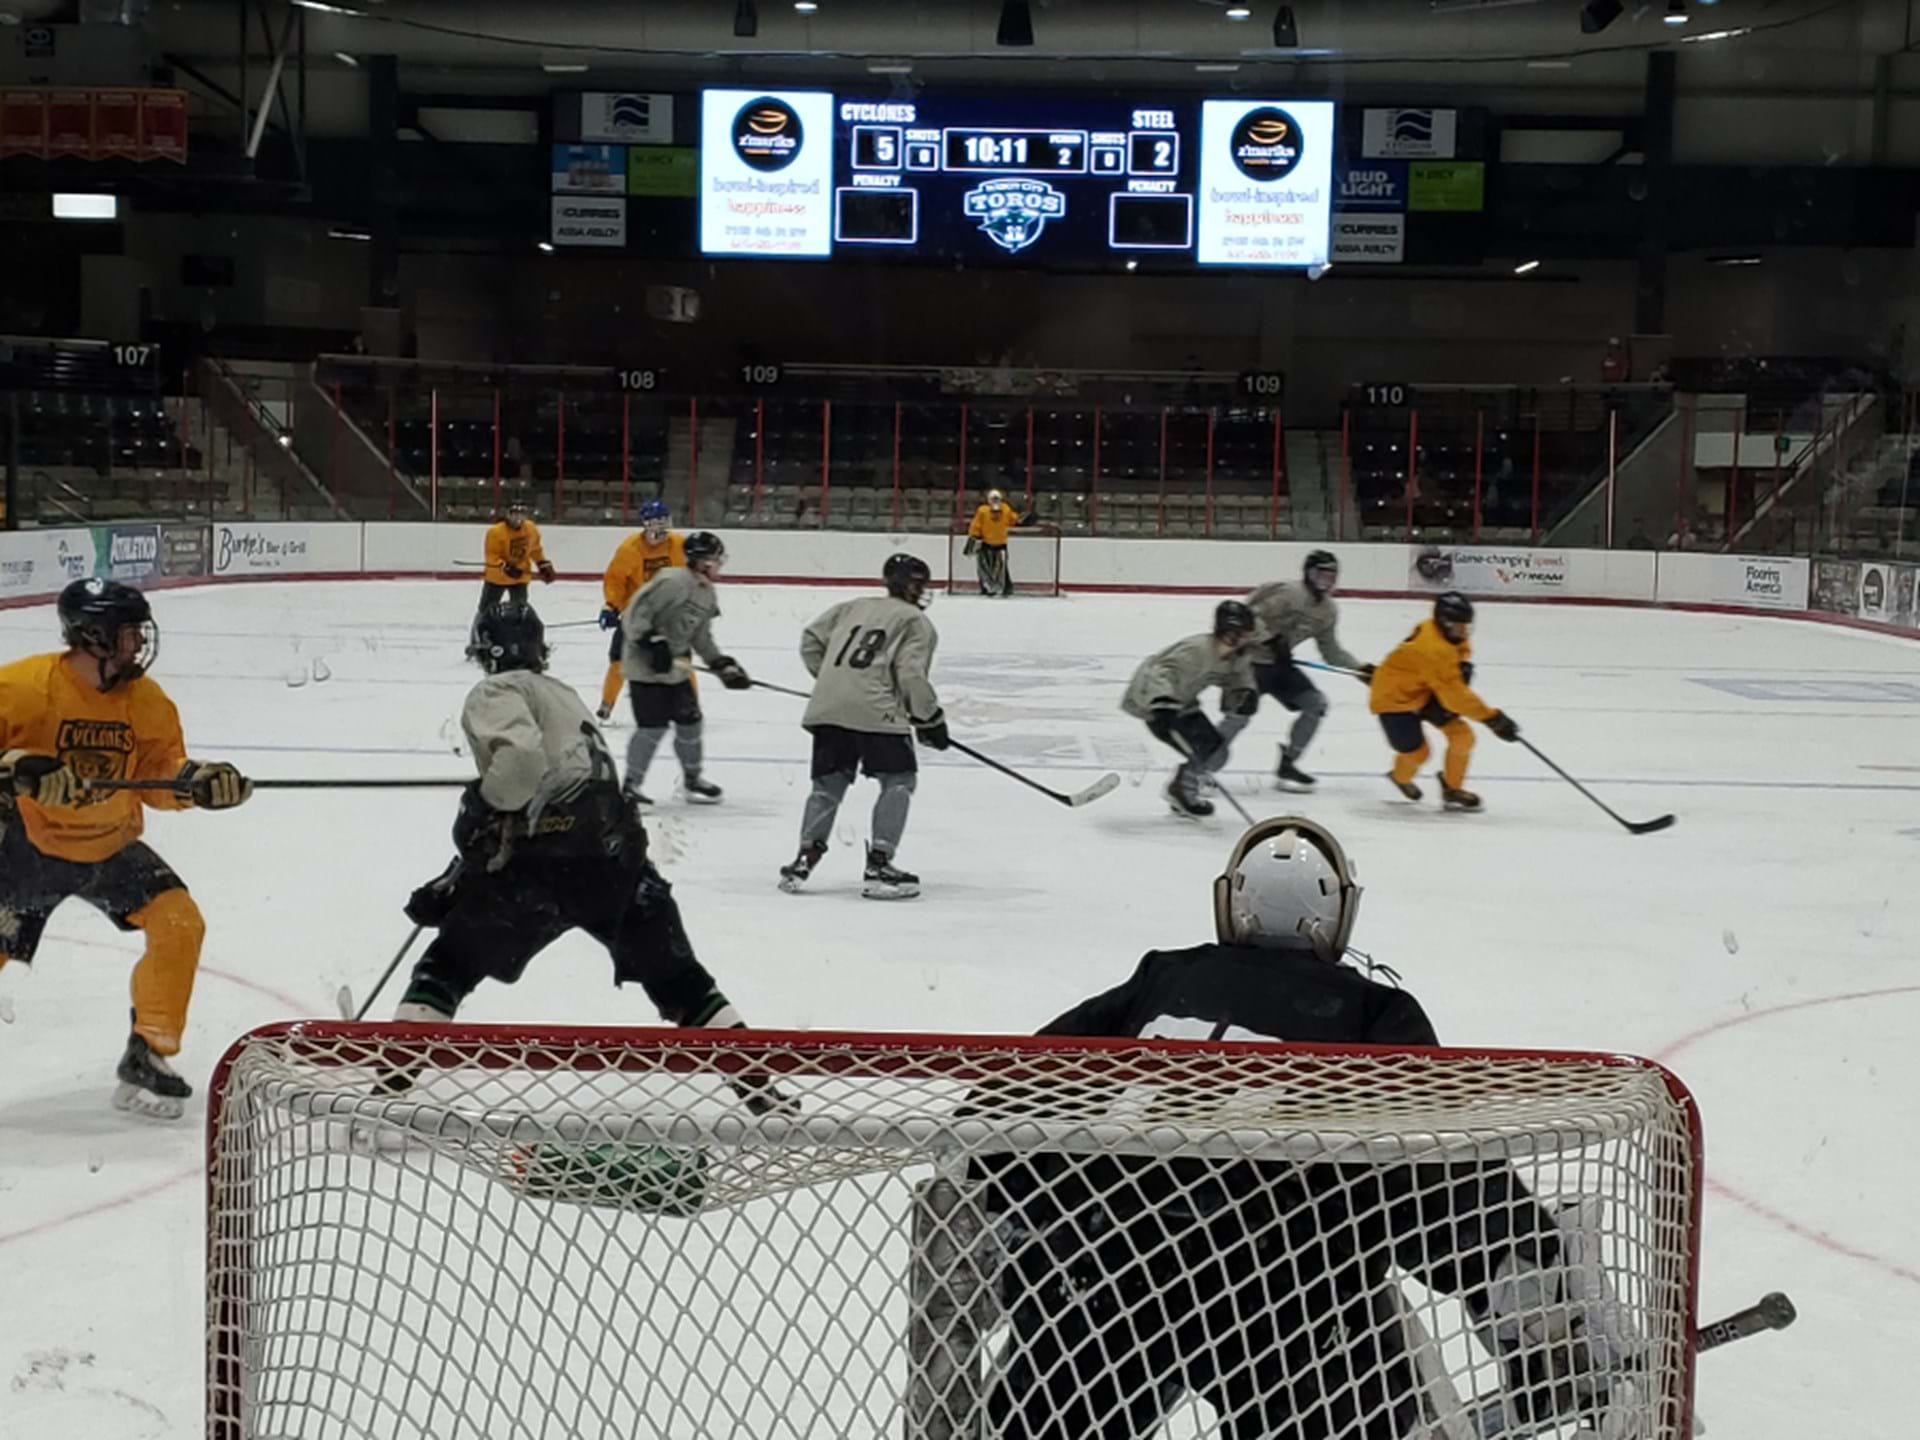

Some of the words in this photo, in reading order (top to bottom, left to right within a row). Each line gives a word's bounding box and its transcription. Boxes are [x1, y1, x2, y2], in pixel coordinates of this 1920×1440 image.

[841, 103, 916, 122] CYCLONES
[1132, 110, 1175, 128] STEEL
[877, 136, 894, 161] 5
[919, 149, 930, 163] 0
[964, 137, 1028, 163] 10:11
[1058, 148, 1071, 165] 2
[1154, 141, 1171, 167] 2
[1104, 153, 1115, 167] 0
[853, 174, 901, 186] PENALTY
[1348, 171, 1388, 183] BUD
[1128, 180, 1177, 193] PENALTY
[1341, 183, 1396, 196] LIGHT
[971, 193, 1059, 211] TOROS
[114, 346, 150, 365] 107
[619, 371, 655, 389] 108
[742, 366, 778, 383] 109
[1245, 375, 1281, 393] 109
[1367, 386, 1403, 404] 110
[216, 527, 265, 572] Burke's
[1746, 566, 1780, 582] Flooring
[1745, 581, 1781, 594] America
[834, 624, 887, 669] 18
[59, 724, 133, 751] CYCLONES
